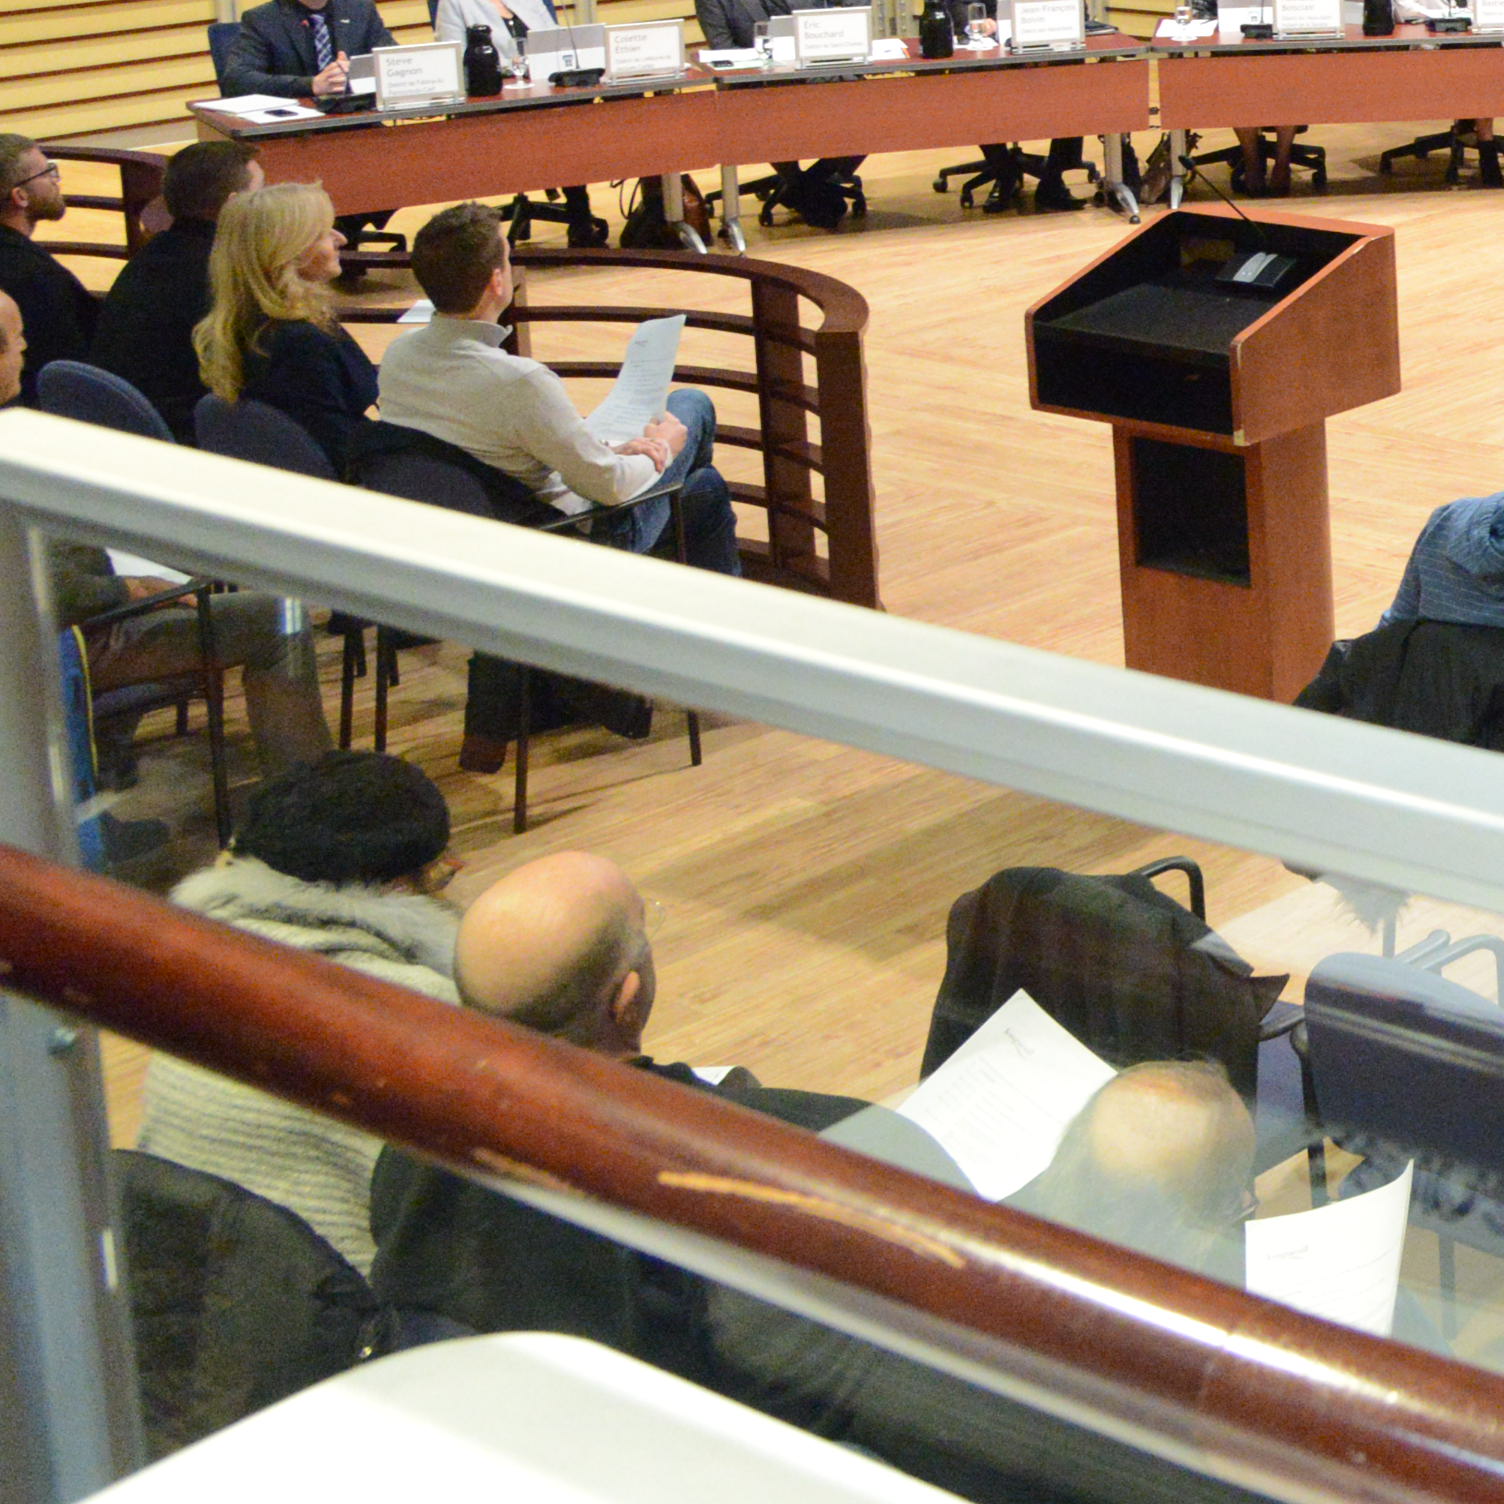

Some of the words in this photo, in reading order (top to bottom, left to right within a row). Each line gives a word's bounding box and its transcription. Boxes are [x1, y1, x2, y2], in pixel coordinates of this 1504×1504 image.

[615, 34, 648, 43] Colette
[803, 29, 845, 40] Bouchard
[385, 56, 414, 67] Steve
[386, 67, 424, 79] Gagnon
